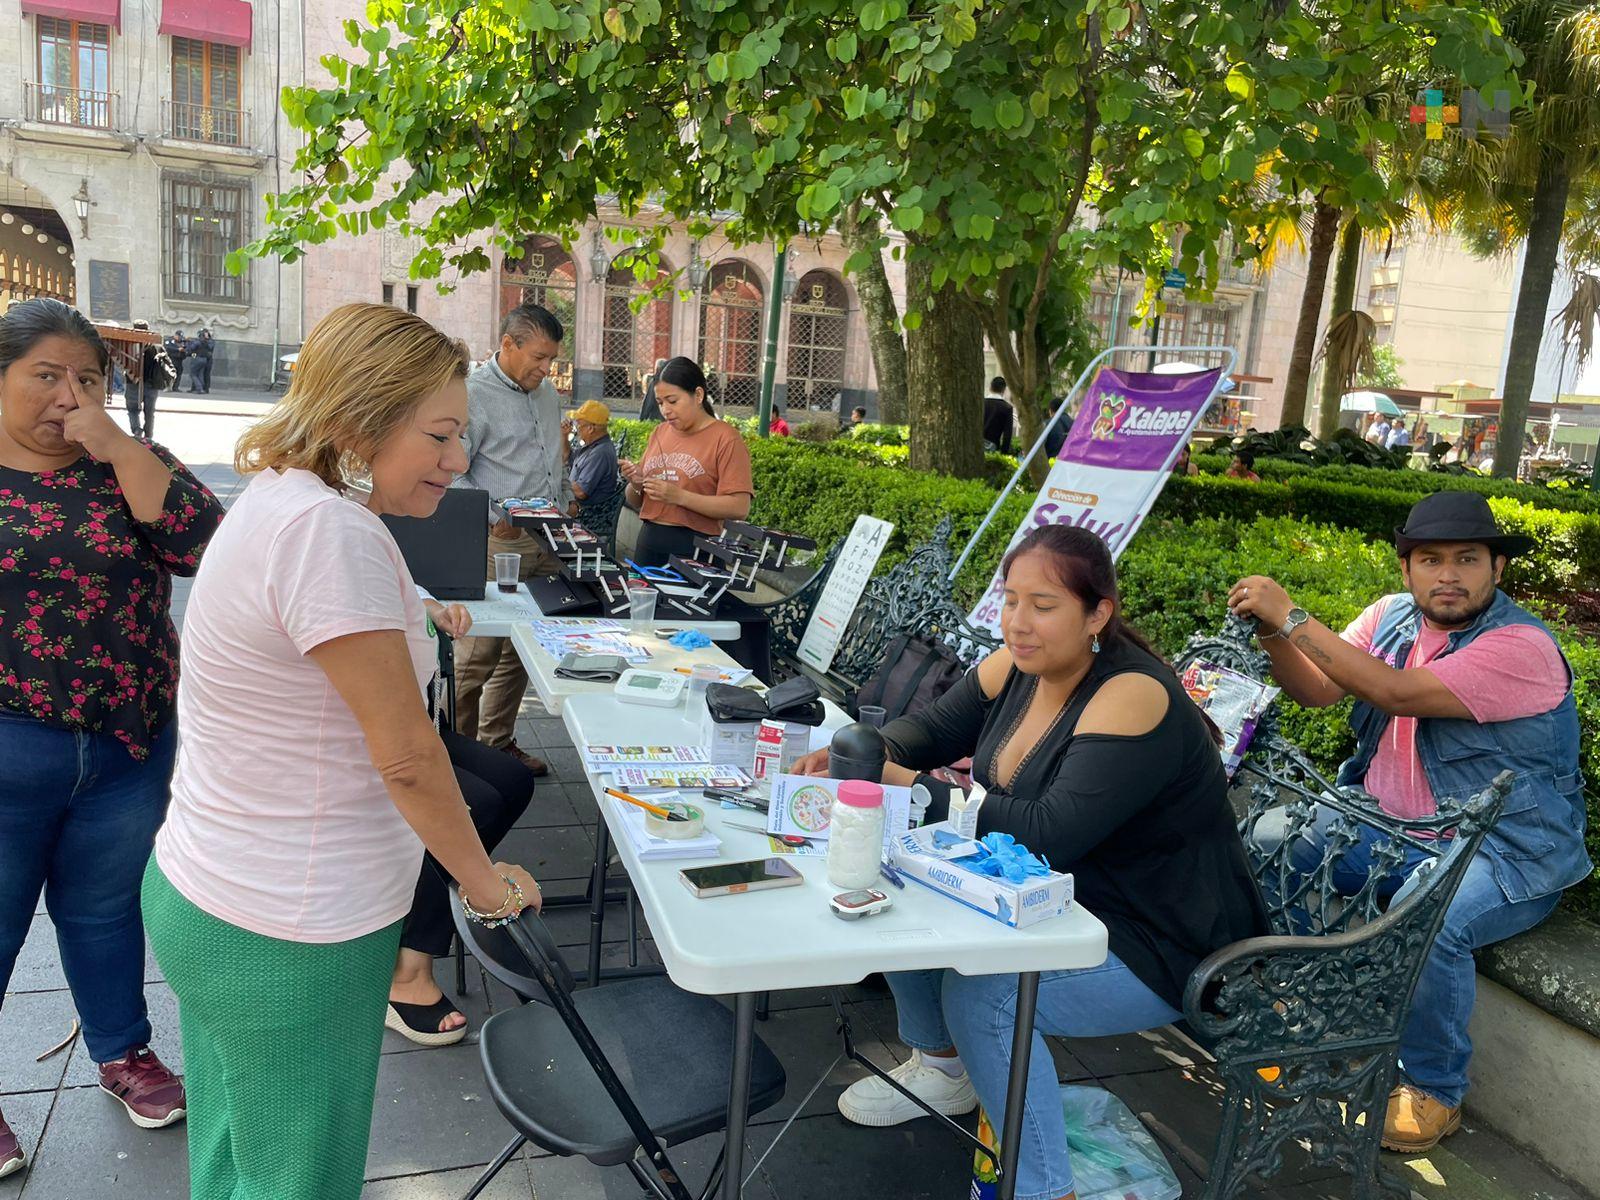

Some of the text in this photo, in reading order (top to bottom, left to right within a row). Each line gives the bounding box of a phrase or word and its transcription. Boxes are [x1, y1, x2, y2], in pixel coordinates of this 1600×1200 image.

[1121, 406, 1192, 435] Xalapa
[866, 524, 883, 547] A
[975, 601, 998, 624] de
